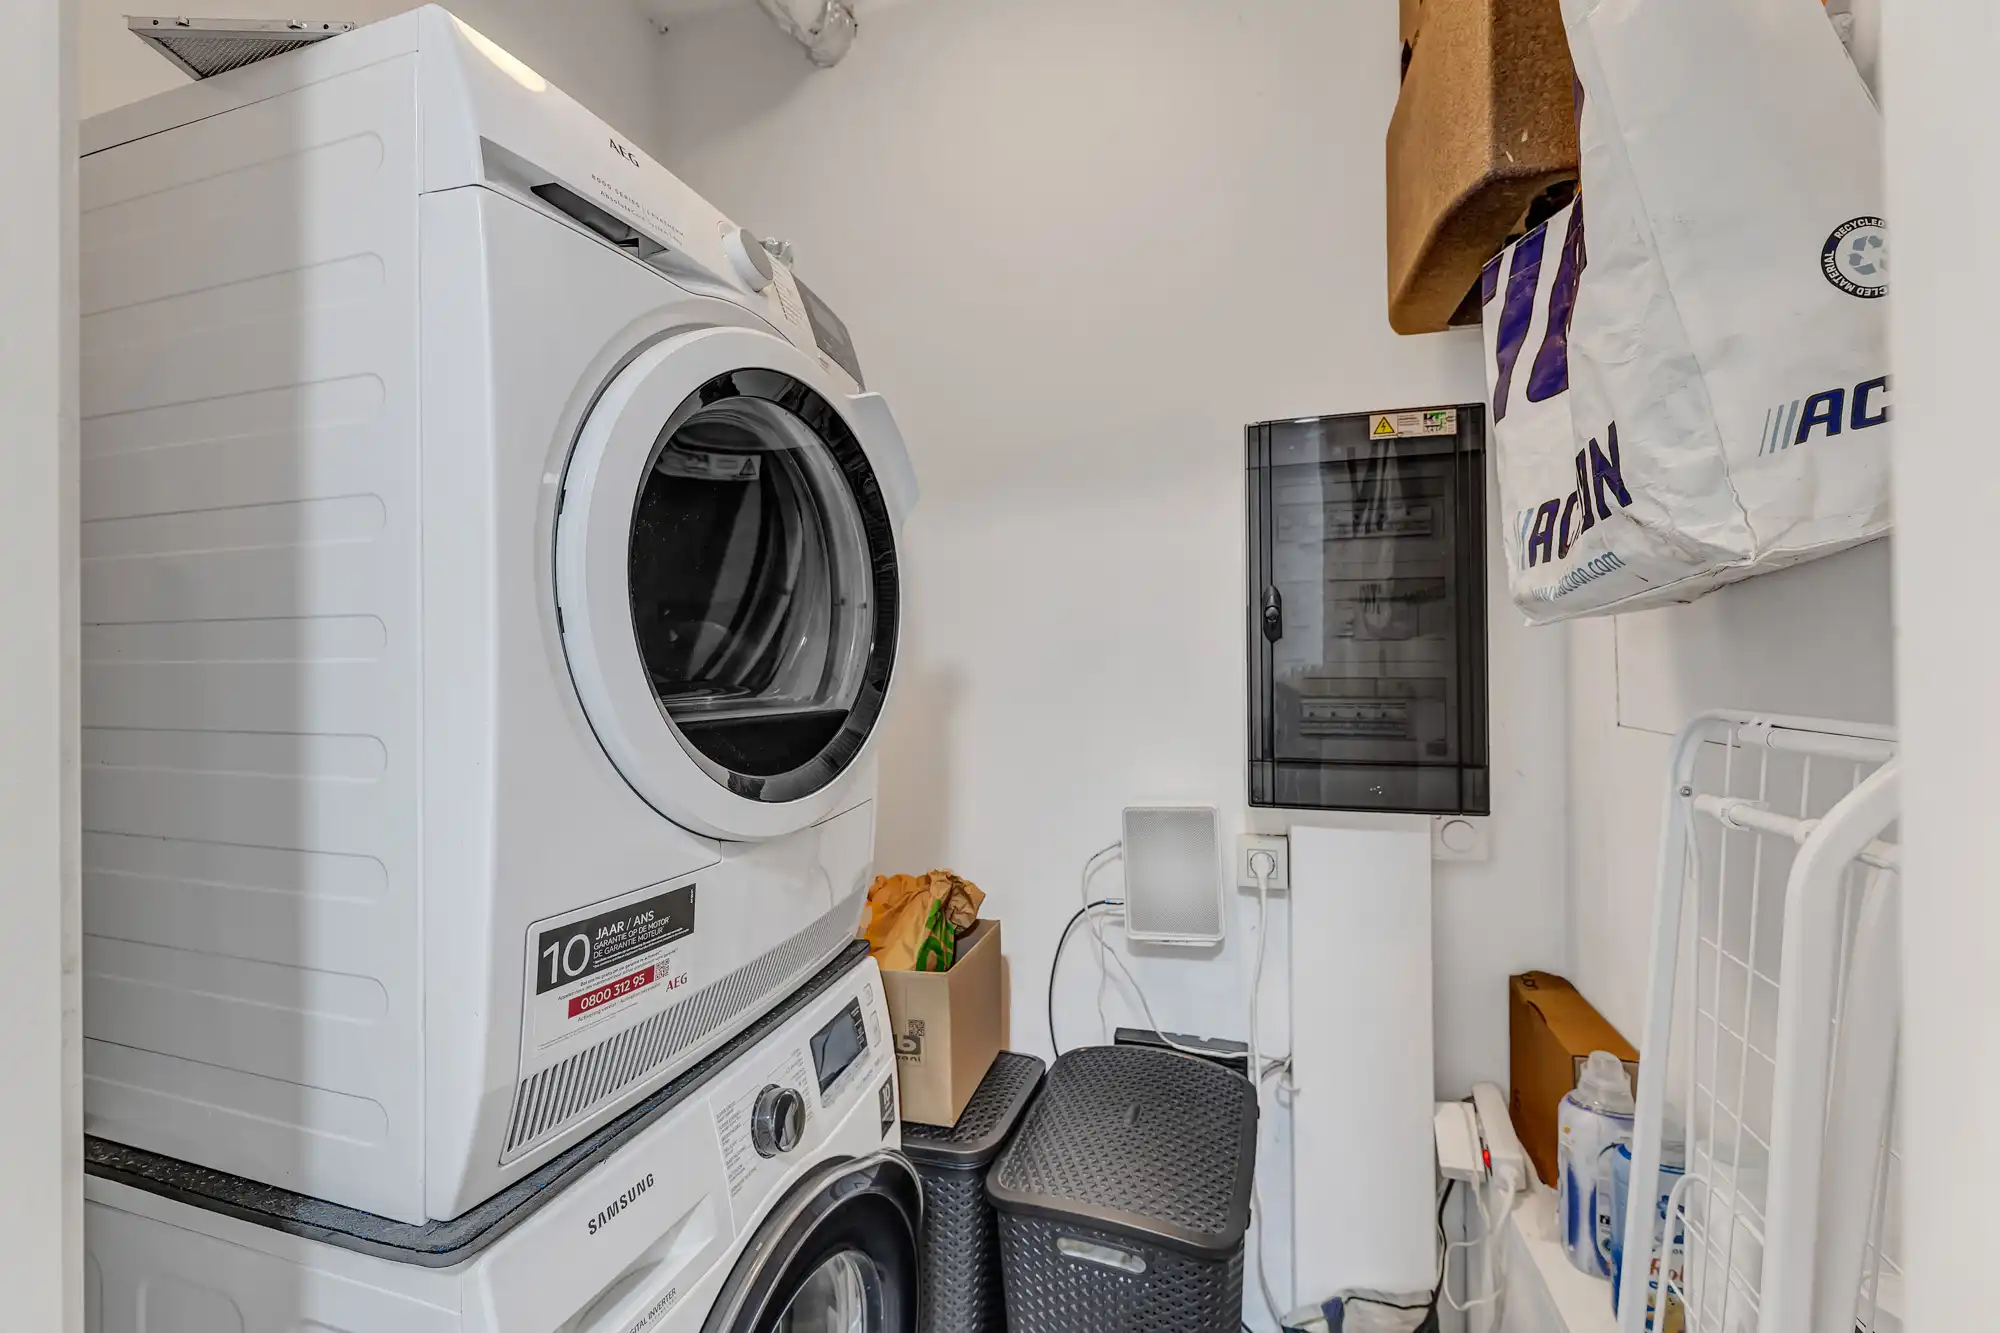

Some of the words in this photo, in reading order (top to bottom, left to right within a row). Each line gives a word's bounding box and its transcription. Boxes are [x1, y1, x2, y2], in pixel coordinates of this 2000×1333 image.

[609, 138, 640, 168] AEG
[614, 188, 640, 208] SERIES
[1833, 218, 1885, 239] RECYCLED
[1824, 250, 1856, 293] MATERIAL
[543, 933, 591, 985] 10
[596, 921, 625, 941] JAAR
[633, 910, 655, 928] ANS
[593, 934, 627, 951] GARANTIE
[628, 928, 638, 938] OP
[638, 924, 648, 935] DE
[593, 949, 603, 959] DE
[604, 937, 637, 955] GARANTIE
[581, 988, 611, 1010] 0800
[613, 979, 631, 996] 312
[632, 973, 645, 988] 95
[665, 972, 688, 993] AEG
[588, 1173, 654, 1236] SAMSUNG
[648, 1287, 677, 1320] INVERTER
